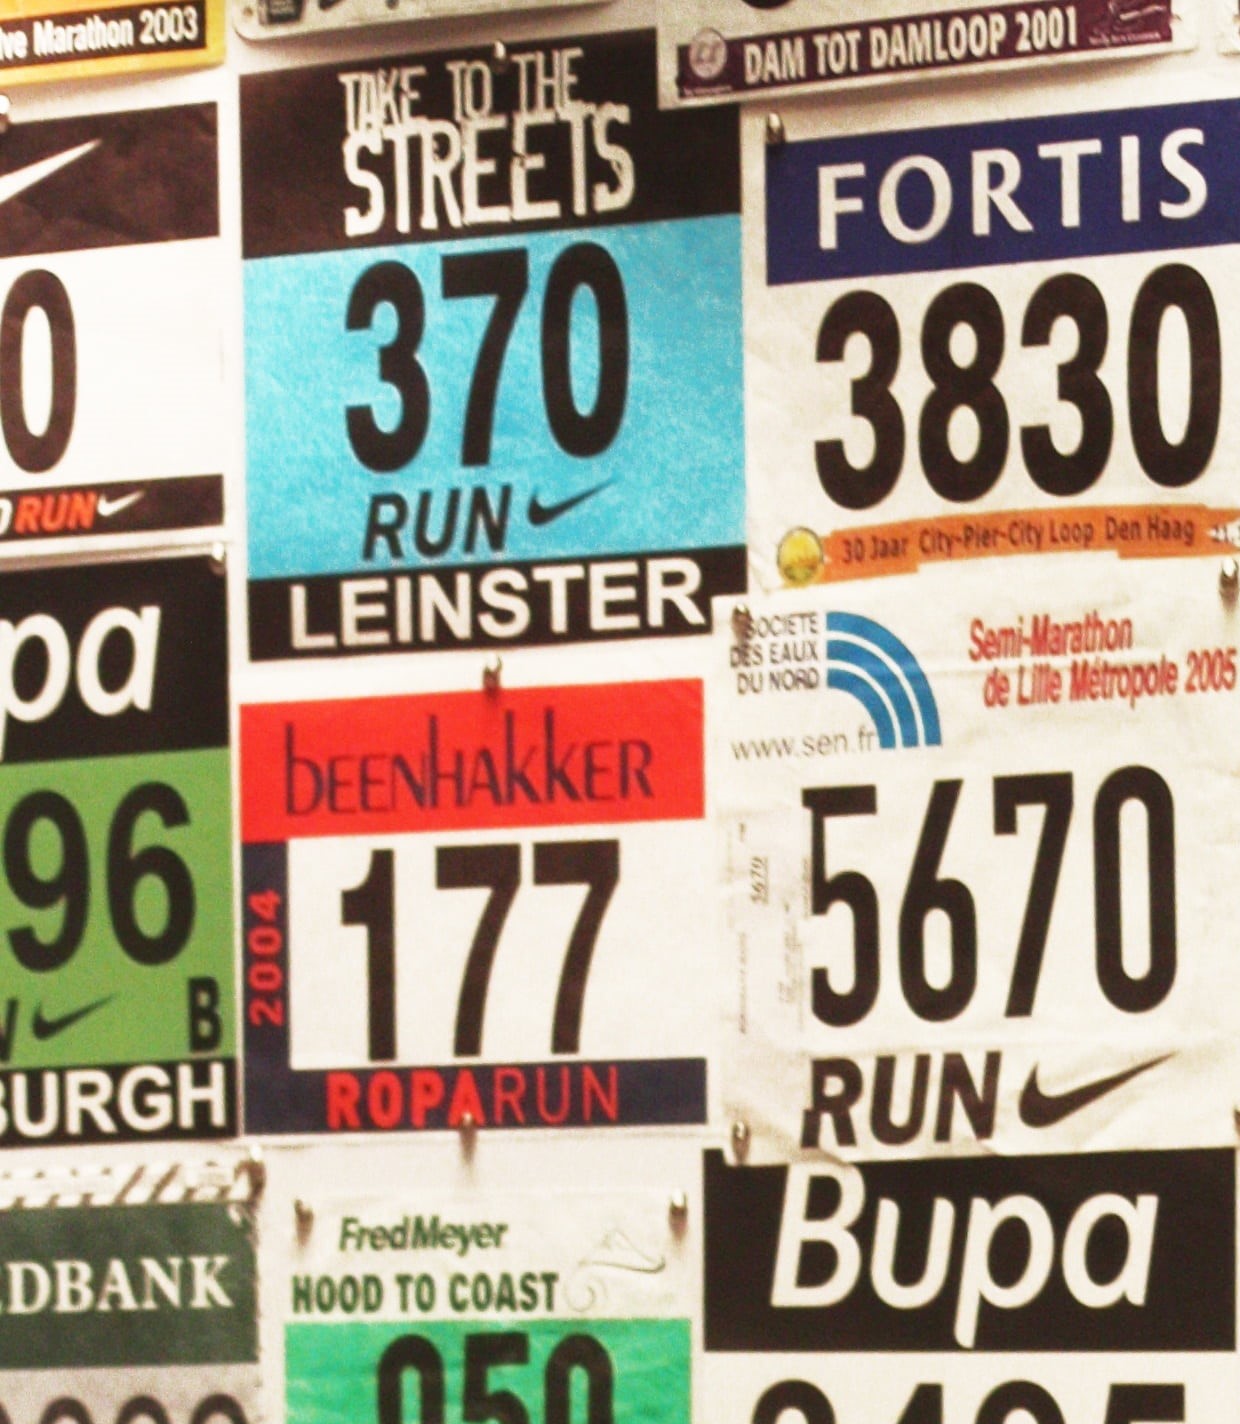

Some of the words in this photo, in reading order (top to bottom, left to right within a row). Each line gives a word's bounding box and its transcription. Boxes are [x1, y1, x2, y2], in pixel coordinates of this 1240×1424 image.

[339, 67, 427, 130] TAKE
[446, 60, 493, 113] TO
[511, 49, 584, 109] THE
[744, 38, 803, 84] DAM
[817, 31, 862, 73] TOT
[870, 13, 1004, 71] DAMLOOP
[1015, 5, 1079, 49] 2001
[344, 104, 636, 238] STREETS
[818, 128, 1209, 251] FORTIS
[345, 241, 630, 474] 370
[814, 263, 1223, 510] 3830
[14, 491, 96, 534] RUN
[362, 484, 512, 561] RUN
[290, 557, 705, 650] LEINSTER
[968, 614, 1134, 661] Semi-Marathon
[802, 765, 1177, 1027] 5670
[248, 890, 284, 1027] 2004
[340, 838, 620, 1062] 177
[186, 976, 223, 1054] B
[801, 1051, 1002, 1148] RUN
[6, 1254, 234, 1315] DBANK
[292, 1274, 383, 1314] HOOD
[396, 1273, 436, 1312] TO
[447, 1271, 558, 1312] COAST
[771, 1158, 1159, 1349] Bupa
